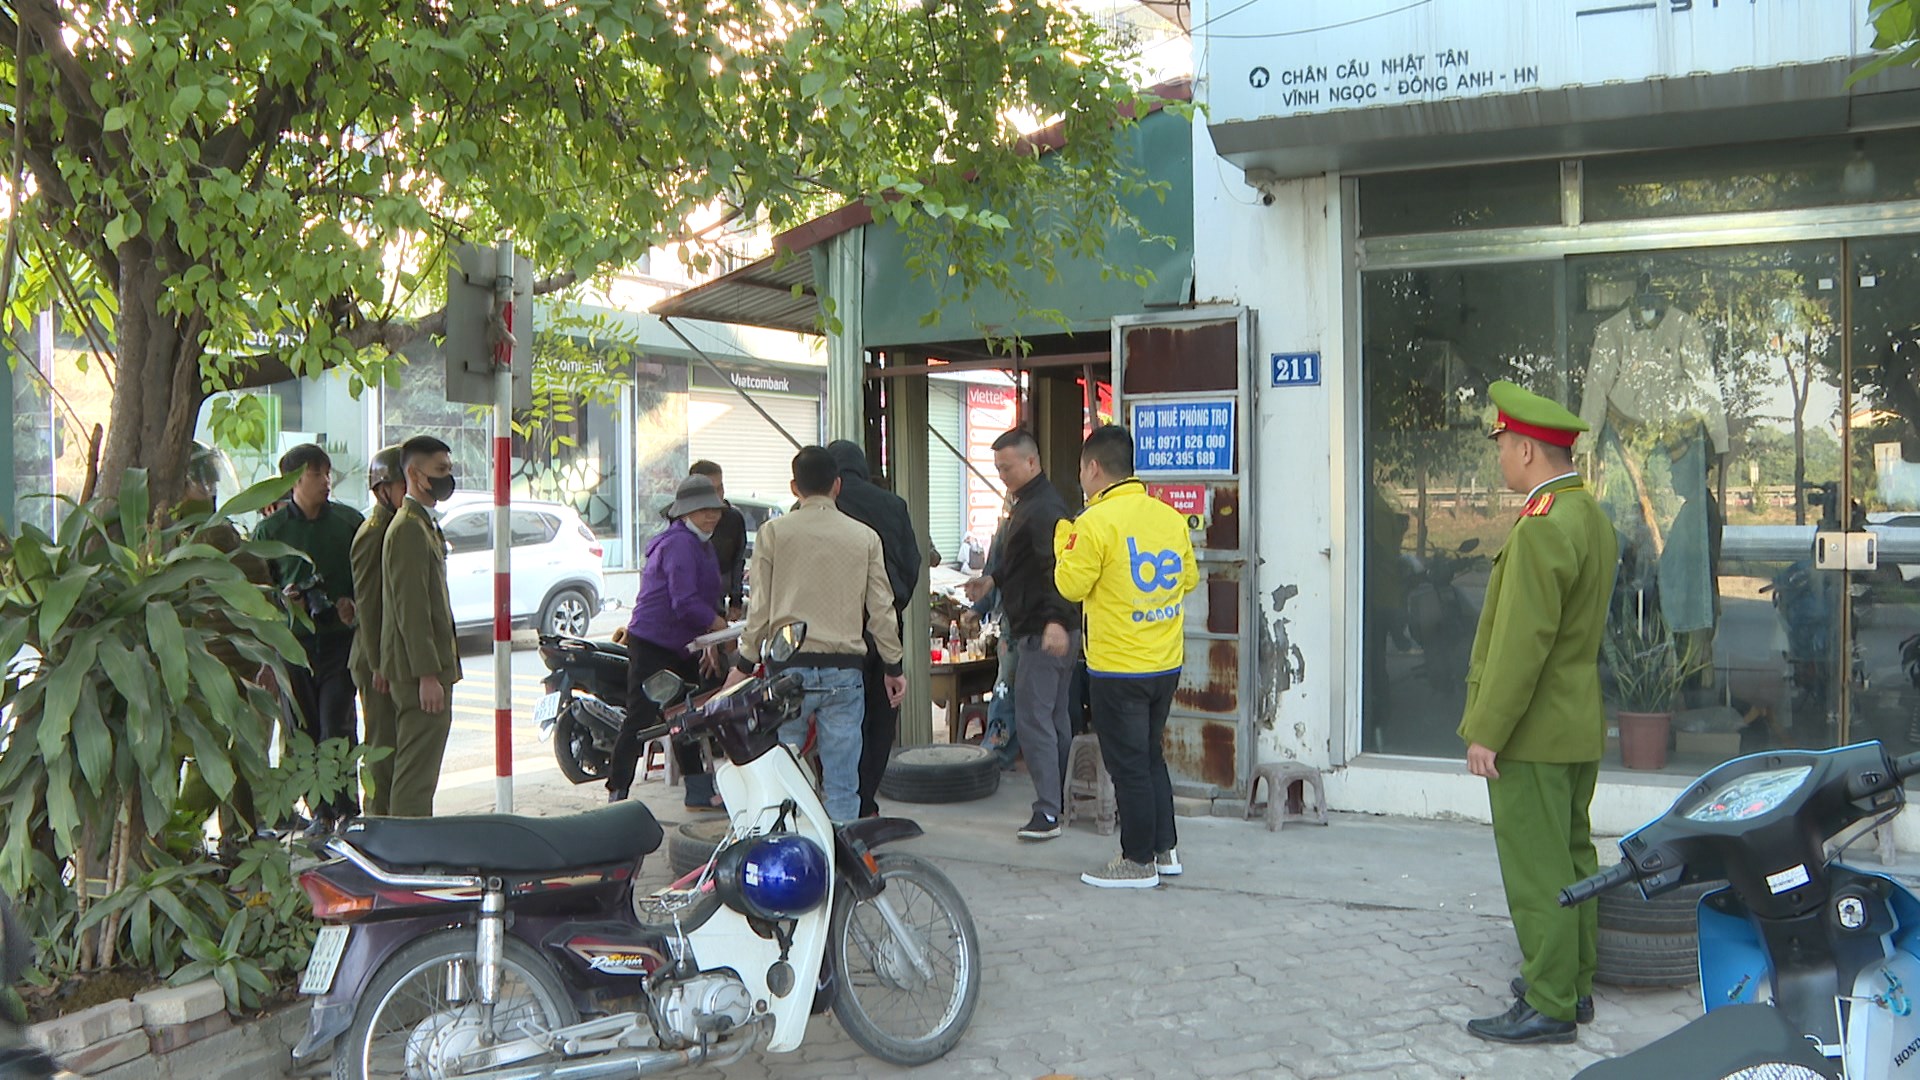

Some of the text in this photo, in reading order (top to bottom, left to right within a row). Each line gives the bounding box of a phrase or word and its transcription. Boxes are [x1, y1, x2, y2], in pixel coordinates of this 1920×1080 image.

[1281, 64, 1327, 85] CHÂN
[1382, 53, 1425, 75] NHẬT
[1436, 48, 1469, 68] TÂN
[1282, 89, 1319, 107] VĨNH
[1329, 83, 1377, 103] NGỌC
[1398, 75, 1448, 95] ĐÔNG
[1457, 71, 1493, 89] ANH
[1514, 65, 1538, 83] HN
[1276, 357, 1313, 381] 211
[730, 372, 789, 391] Vietcombank
[1138, 410, 1155, 428] CHO
[1157, 406, 1178, 428] THUÊ
[1211, 408, 1228, 430] TRỌ
[1157, 436, 1181, 450] 0971
[1206, 434, 1226, 448] 000
[1148, 452, 1173, 466] 0962
[1176, 451, 1194, 465] 395
[1126, 537, 1182, 593] be
